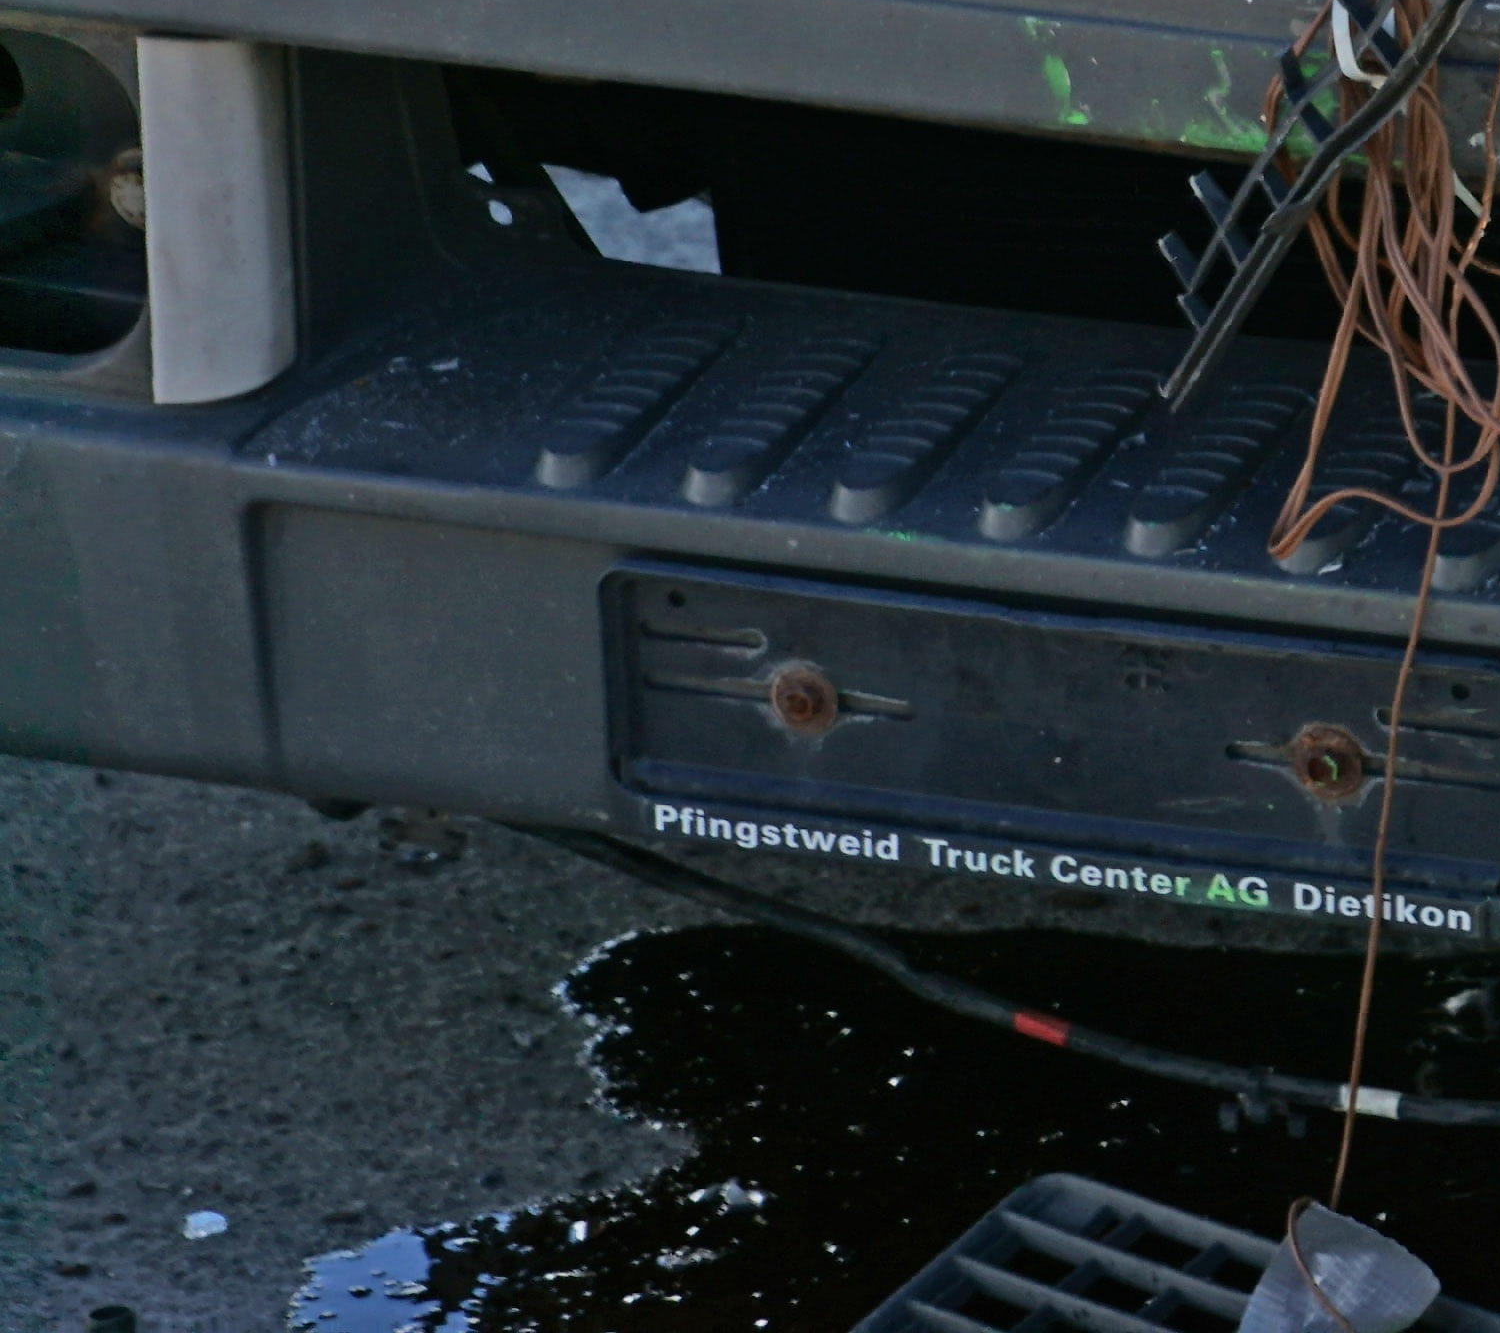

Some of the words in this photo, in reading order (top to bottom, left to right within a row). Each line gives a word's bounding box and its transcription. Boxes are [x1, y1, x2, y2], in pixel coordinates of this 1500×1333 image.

[653, 804, 900, 863] Pfingstweid
[923, 837, 1036, 881] Truck
[1050, 854, 1196, 899] Center
[1206, 874, 1270, 909] AG
[1293, 881, 1473, 933] Dietikon
